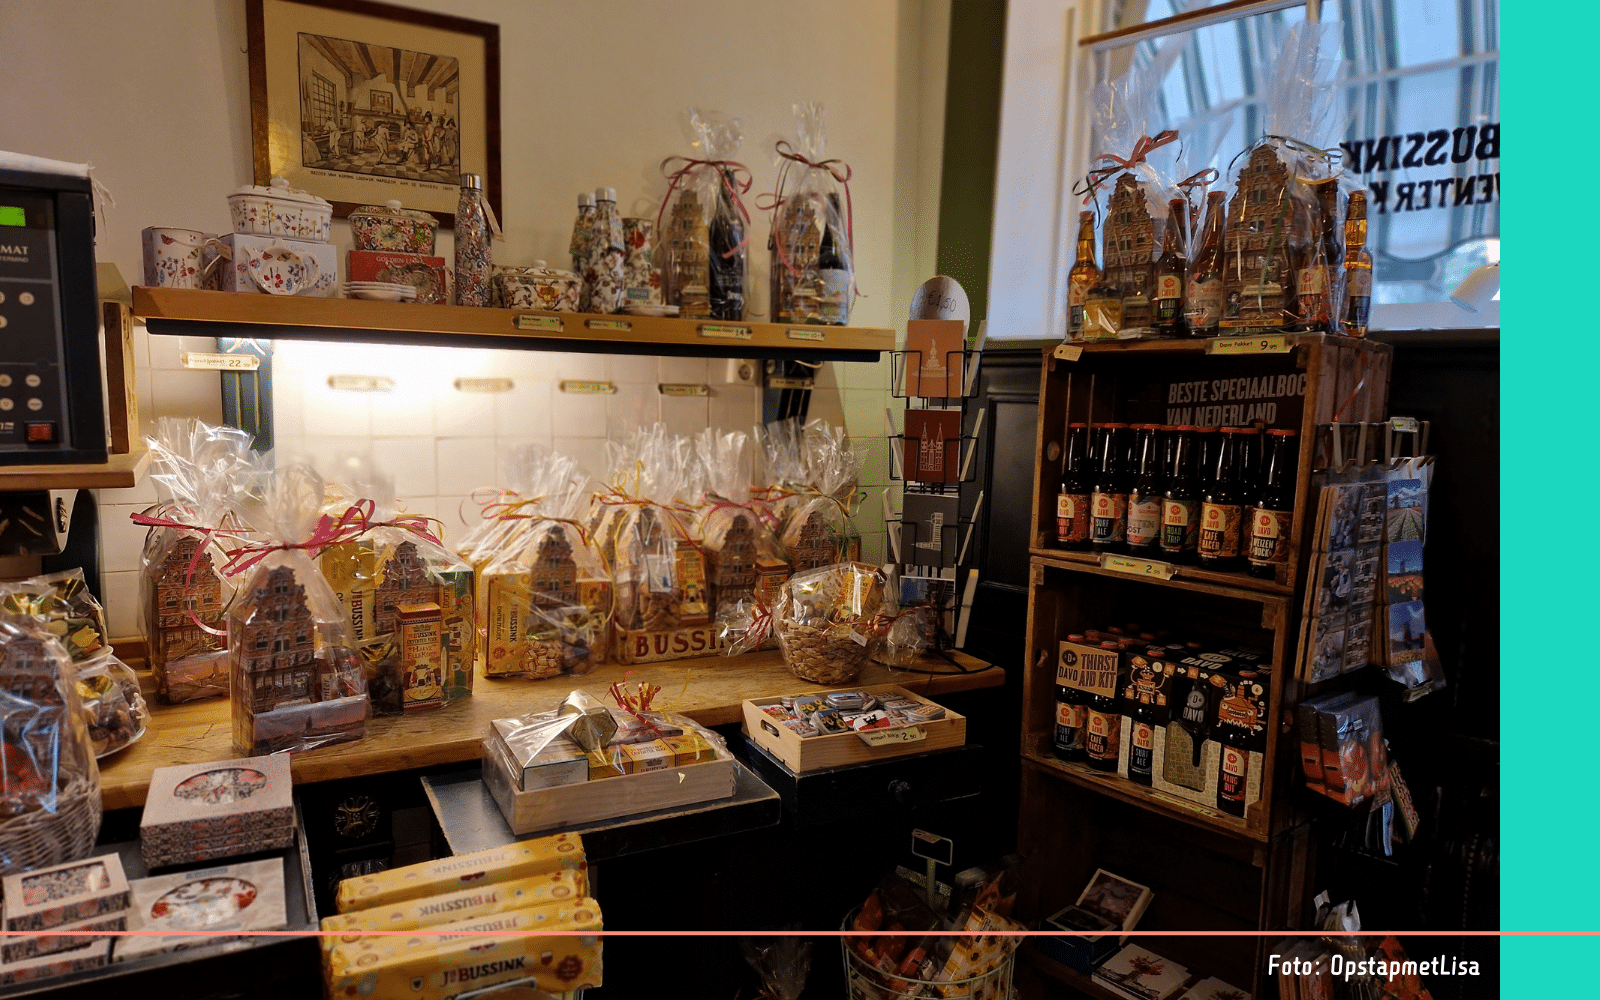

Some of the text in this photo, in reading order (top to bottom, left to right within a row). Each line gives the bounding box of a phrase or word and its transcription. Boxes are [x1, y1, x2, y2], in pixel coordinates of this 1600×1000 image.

[1260, 340, 1269, 351] 9
[1168, 380, 1209, 404] BESTE
[1167, 402, 1277, 427] VAN NEDERLAND
[1146, 564, 1153, 574] 2
[635, 629, 734, 658] BUSSIN
[1081, 653, 1117, 672] THIRST
[1058, 665, 1078, 682] DAVO
[1078, 670, 1116, 689] AID KIT
[1182, 706, 1205, 723] DAVO
[901, 732, 909, 740] 2
[1136, 757, 1147, 767] ALE
[458, 956, 525, 982] BUSSINK
